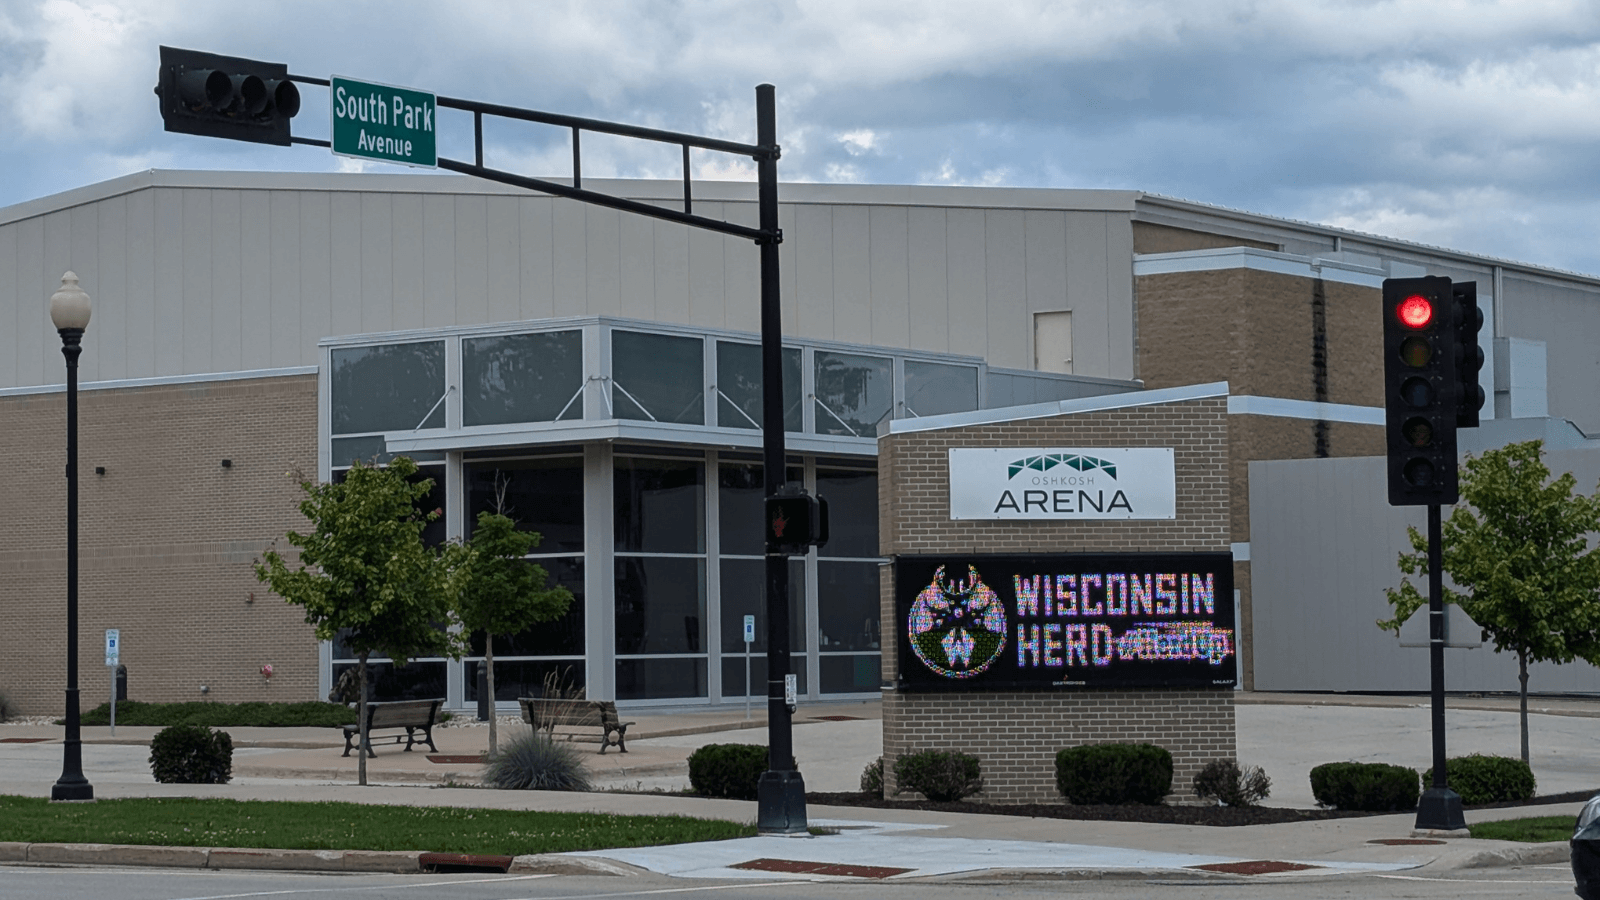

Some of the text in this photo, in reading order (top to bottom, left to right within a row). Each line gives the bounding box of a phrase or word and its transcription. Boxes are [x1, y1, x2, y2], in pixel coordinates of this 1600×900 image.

[336, 86, 432, 132] South Park
[358, 128, 412, 156] Avenue
[1031, 476, 1095, 486] OSHKOSH
[993, 489, 1134, 514] ARENA
[1013, 572, 1215, 617] WISCONSIN
[1017, 622, 1113, 667] HERD
